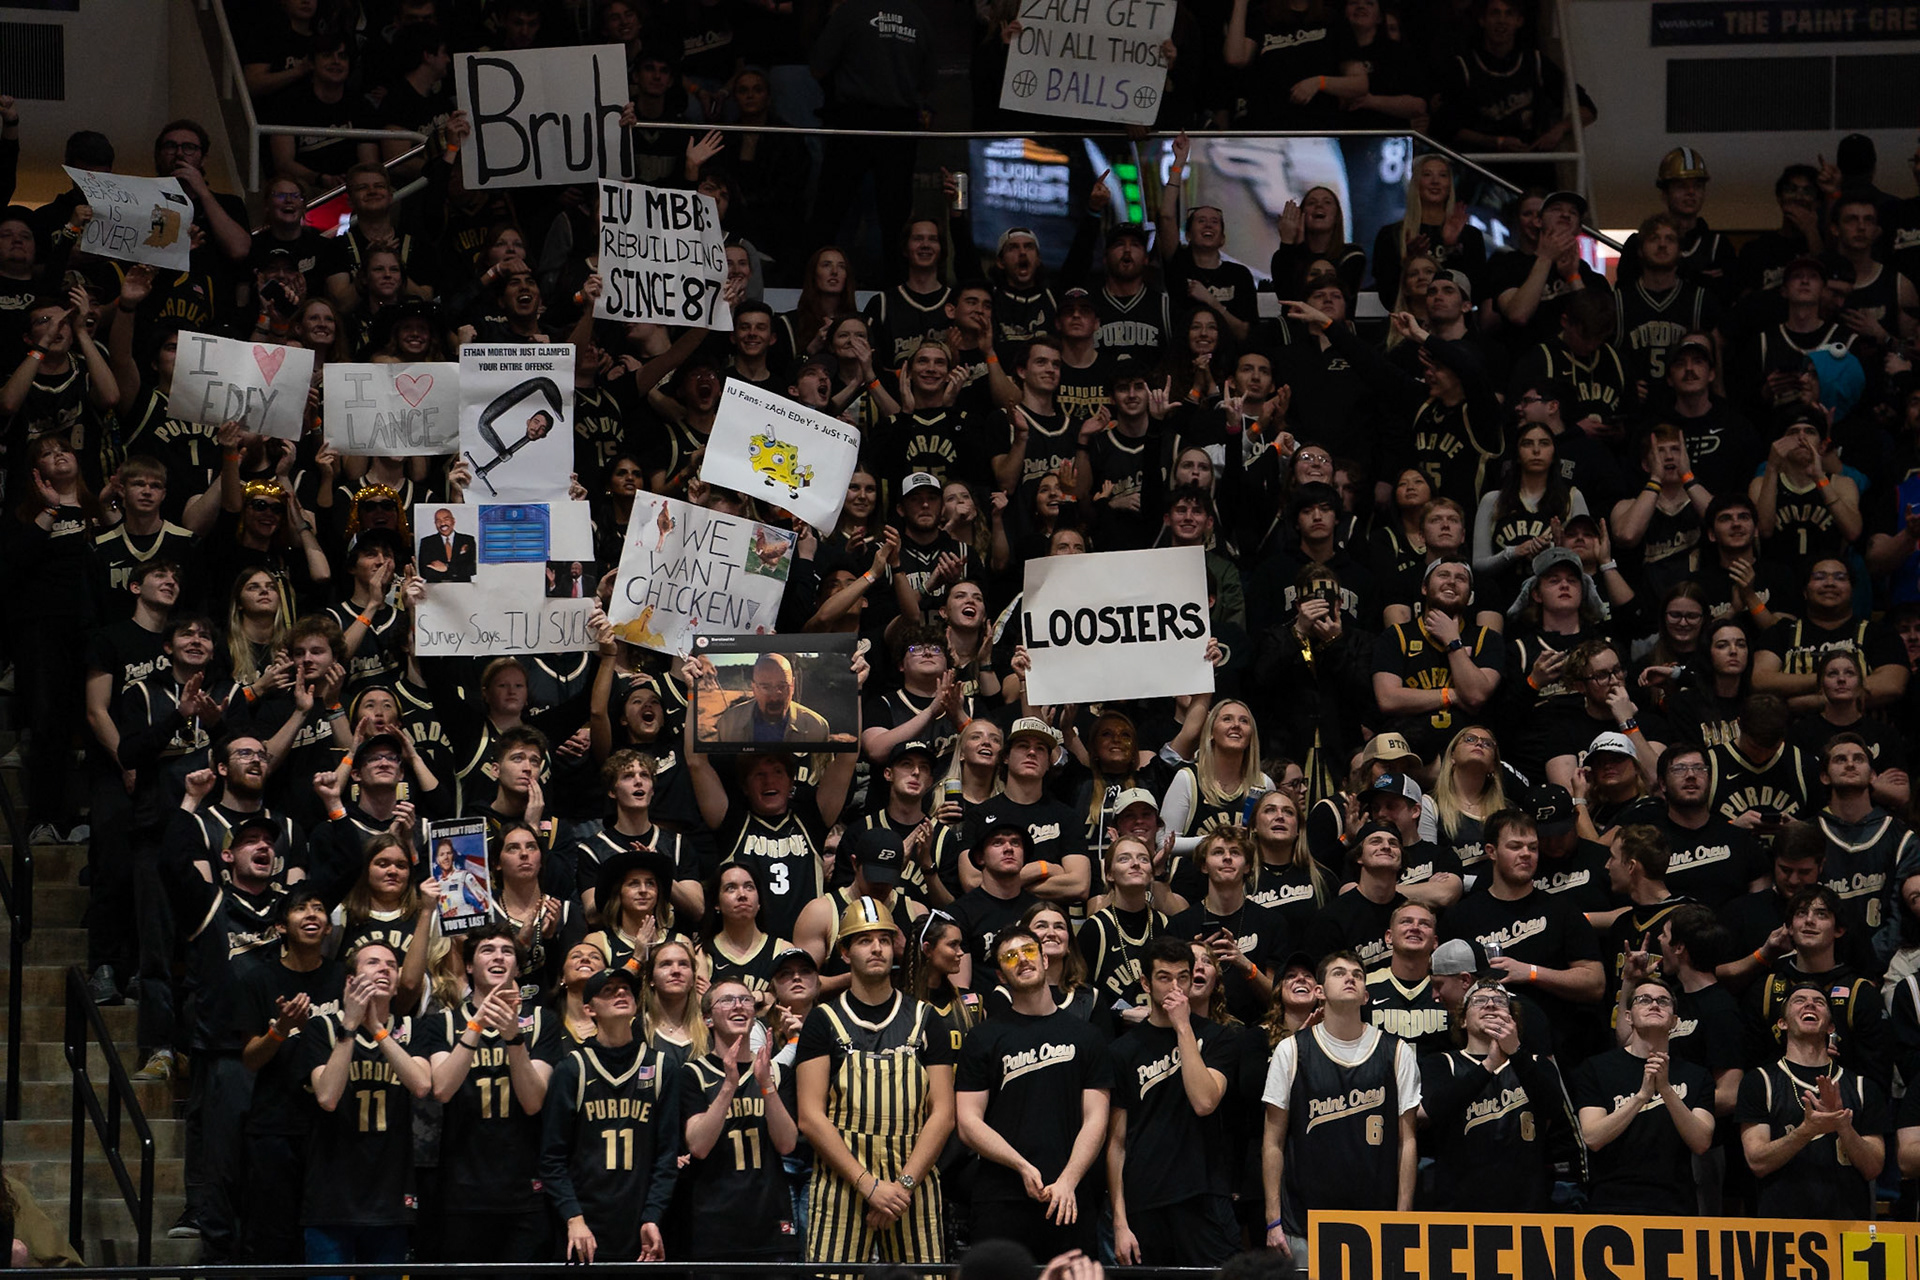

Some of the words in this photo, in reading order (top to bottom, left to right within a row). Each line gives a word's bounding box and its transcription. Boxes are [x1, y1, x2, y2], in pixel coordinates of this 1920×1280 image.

[1021, 0, 1089, 24] ZACH
[1107, 0, 1165, 29] GET
[1724, 10, 1769, 35] THE
[1781, 8, 1858, 34] PAINT
[1018, 26, 1052, 57] ON
[1060, 31, 1097, 61] ALL
[1046, 67, 1131, 110] BALLS
[467, 54, 632, 185] Bruh
[81, 177, 117, 190] YOUR
[82, 185, 139, 206] SEASON
[109, 204, 121, 222] IS
[602, 184, 632, 225] IU
[645, 189, 712, 233] MBB:
[86, 219, 139, 254] OVER!
[606, 267, 675, 318] SINCE
[1094, 320, 1159, 348] PURDUE
[189, 336, 218, 376] I
[463, 348, 485, 357] ETHAN
[488, 348, 517, 357] MORTON
[519, 348, 535, 356] JUST
[538, 347, 570, 356] CLAMPED
[479, 362, 497, 371] YOUR
[500, 362, 522, 371] ENTIRE
[1650, 348, 1666, 378] 5
[344, 372, 377, 409] I
[727, 385, 737, 396] IU
[738, 390, 762, 407] Fans:
[1059, 385, 1104, 397] PURDUE
[200, 380, 279, 434] EDEY
[346, 406, 444, 450] LANCE
[188, 439, 202, 467] 1
[683, 512, 736, 558] WE
[1796, 527, 1808, 555] 1
[649, 550, 740, 592] WANT
[626, 576, 761, 631] CHICKEN!
[417, 613, 466, 653] Survey
[504, 611, 541, 650] IU
[1024, 602, 1206, 649] LOOSIERS
[743, 833, 809, 859] PURDUE
[1694, 844, 1731, 861] Crew
[768, 862, 791, 895] 3
[1279, 883, 1313, 901] Crew
[1551, 870, 1591, 888] Crew
[468, 916, 485, 927] LAST
[1511, 915, 1546, 935] Crew
[1865, 897, 1883, 929] 6
[1371, 1008, 1448, 1039] PURDUE
[1001, 1047, 1038, 1076] Paint
[1039, 1042, 1076, 1062] Crew
[1137, 1053, 1171, 1086] Paint
[355, 1088, 388, 1133] 11
[475, 1076, 510, 1120] 11
[585, 1098, 652, 1124] PURDUE
[1308, 1094, 1348, 1119] Paint
[1348, 1085, 1387, 1107] Crew
[1466, 1096, 1500, 1122] Paint
[1365, 1114, 1384, 1146] 6
[1519, 1110, 1537, 1142] 6
[601, 1127, 634, 1172] 11
[727, 1127, 762, 1172] 11
[1318, 1222, 1684, 1280] DEFENSE
[1696, 1229, 1829, 1280] LIVES
